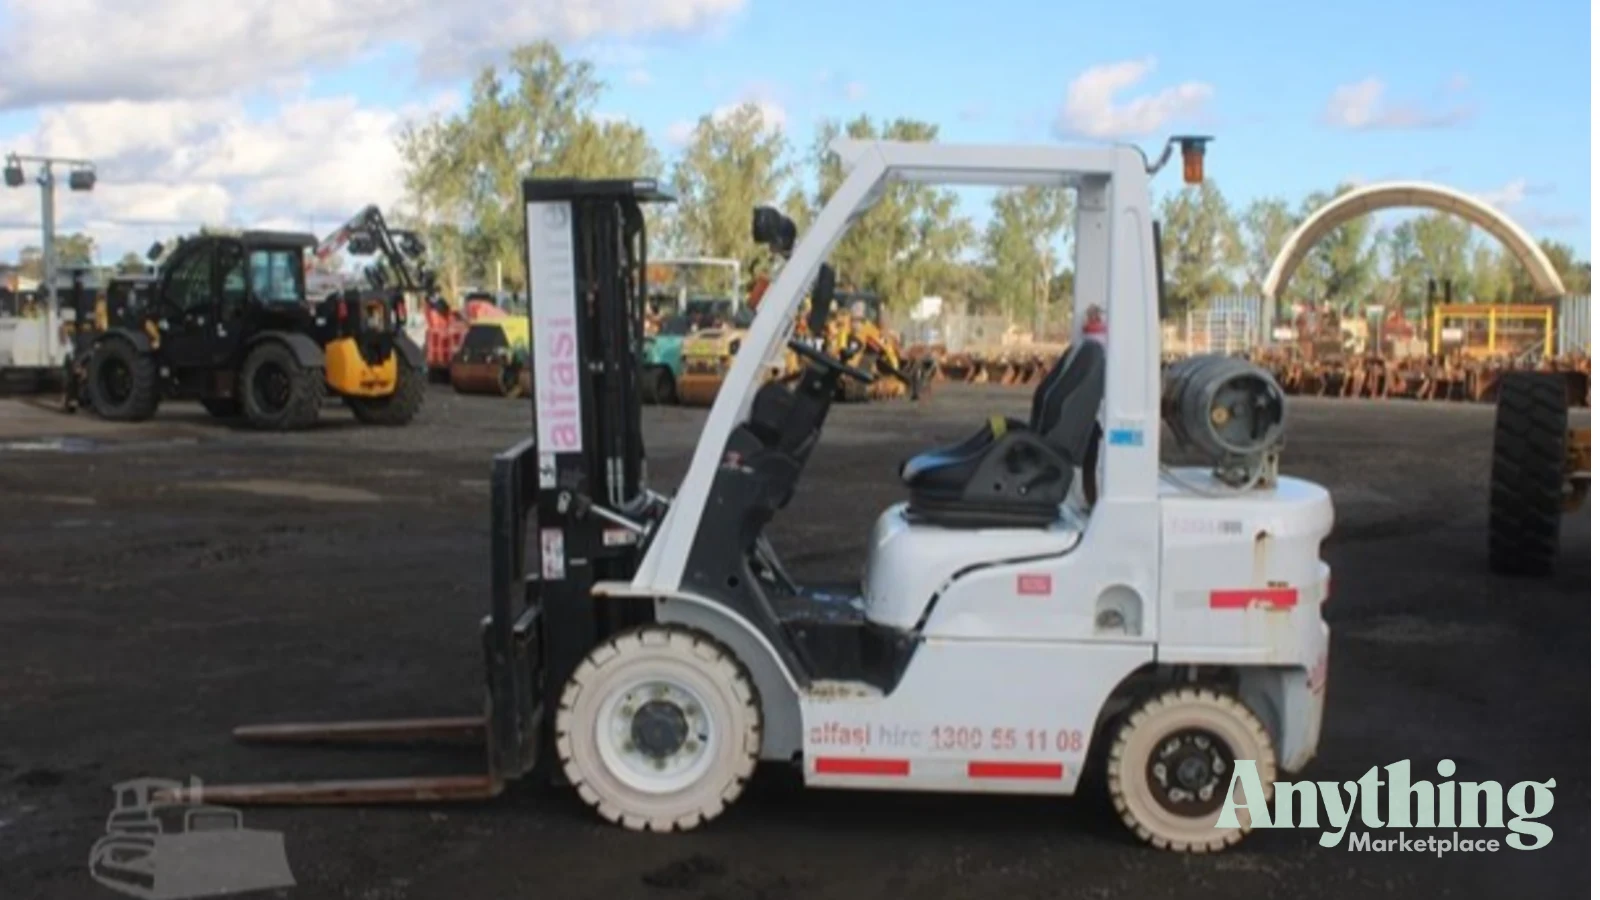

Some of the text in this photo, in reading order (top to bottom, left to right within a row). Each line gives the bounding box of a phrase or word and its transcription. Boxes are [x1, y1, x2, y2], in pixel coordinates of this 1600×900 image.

[541, 315, 577, 448] alfasi
[809, 722, 871, 746] alfasi
[930, 725, 984, 750] 1300
[1025, 730, 1048, 752] 11
[1055, 730, 1084, 753] 08
